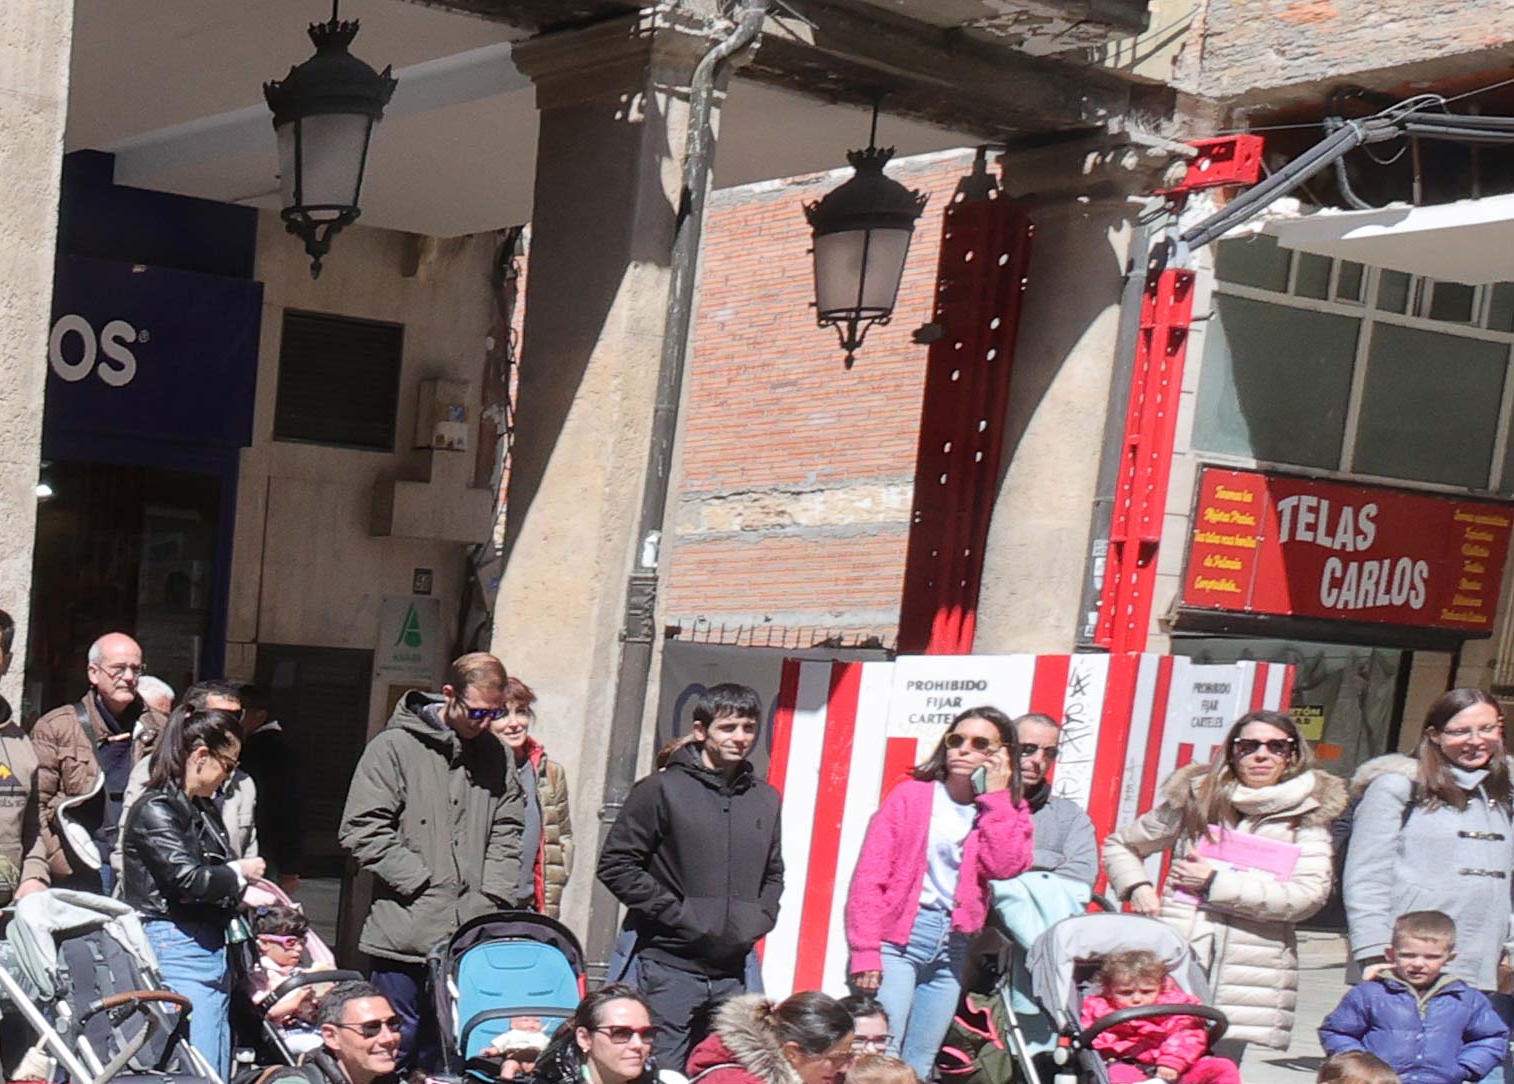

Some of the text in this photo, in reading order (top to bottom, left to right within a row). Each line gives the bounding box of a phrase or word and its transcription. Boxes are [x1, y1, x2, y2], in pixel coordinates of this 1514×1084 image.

[1277, 495, 1379, 552] TELAS
[1319, 556, 1429, 610] CARLOS
[906, 679, 988, 691] PROHIBIDO
[1193, 682, 1231, 695] PROHIBIDO
[926, 696, 963, 710] FIJAR
[1201, 700, 1219, 714] FIJAR
[1190, 716, 1224, 729] CARTELES
